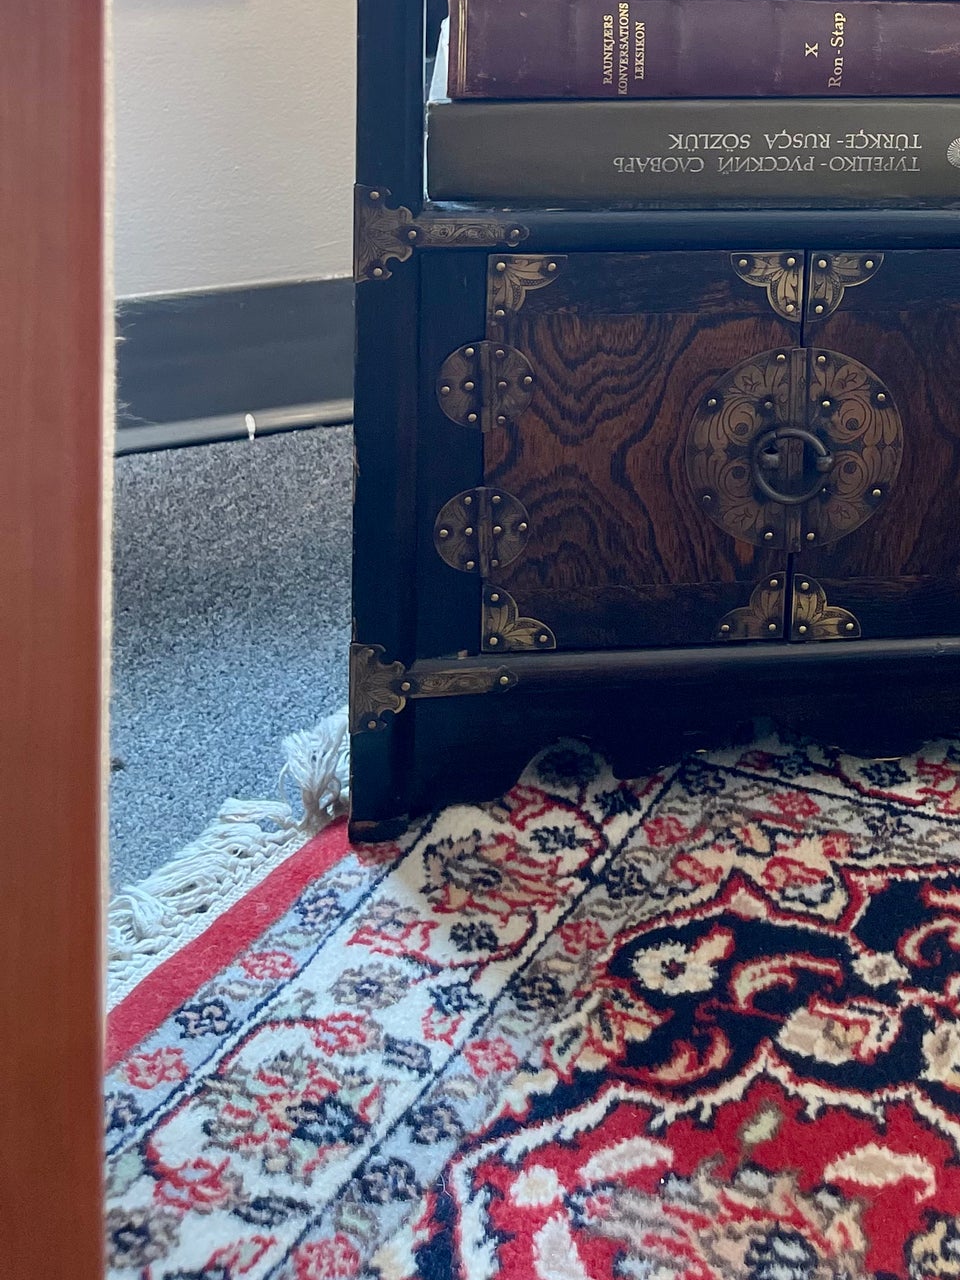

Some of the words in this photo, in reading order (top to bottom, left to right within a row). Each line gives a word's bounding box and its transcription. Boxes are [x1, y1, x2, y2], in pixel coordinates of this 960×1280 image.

[603, 14, 615, 85] RAUNKJÆRS
[618, 2, 629, 95] KONVERSATIONS
[635, 21, 645, 80] LEKSIKON
[805, 42, 819, 58] X
[668, 133, 751, 152] SÖZLÜK
[764, 129, 831, 150] RUSÇA
[613, 156, 705, 173] СЛОВАРЬ
[718, 156, 815, 174] РУССКИЙ
